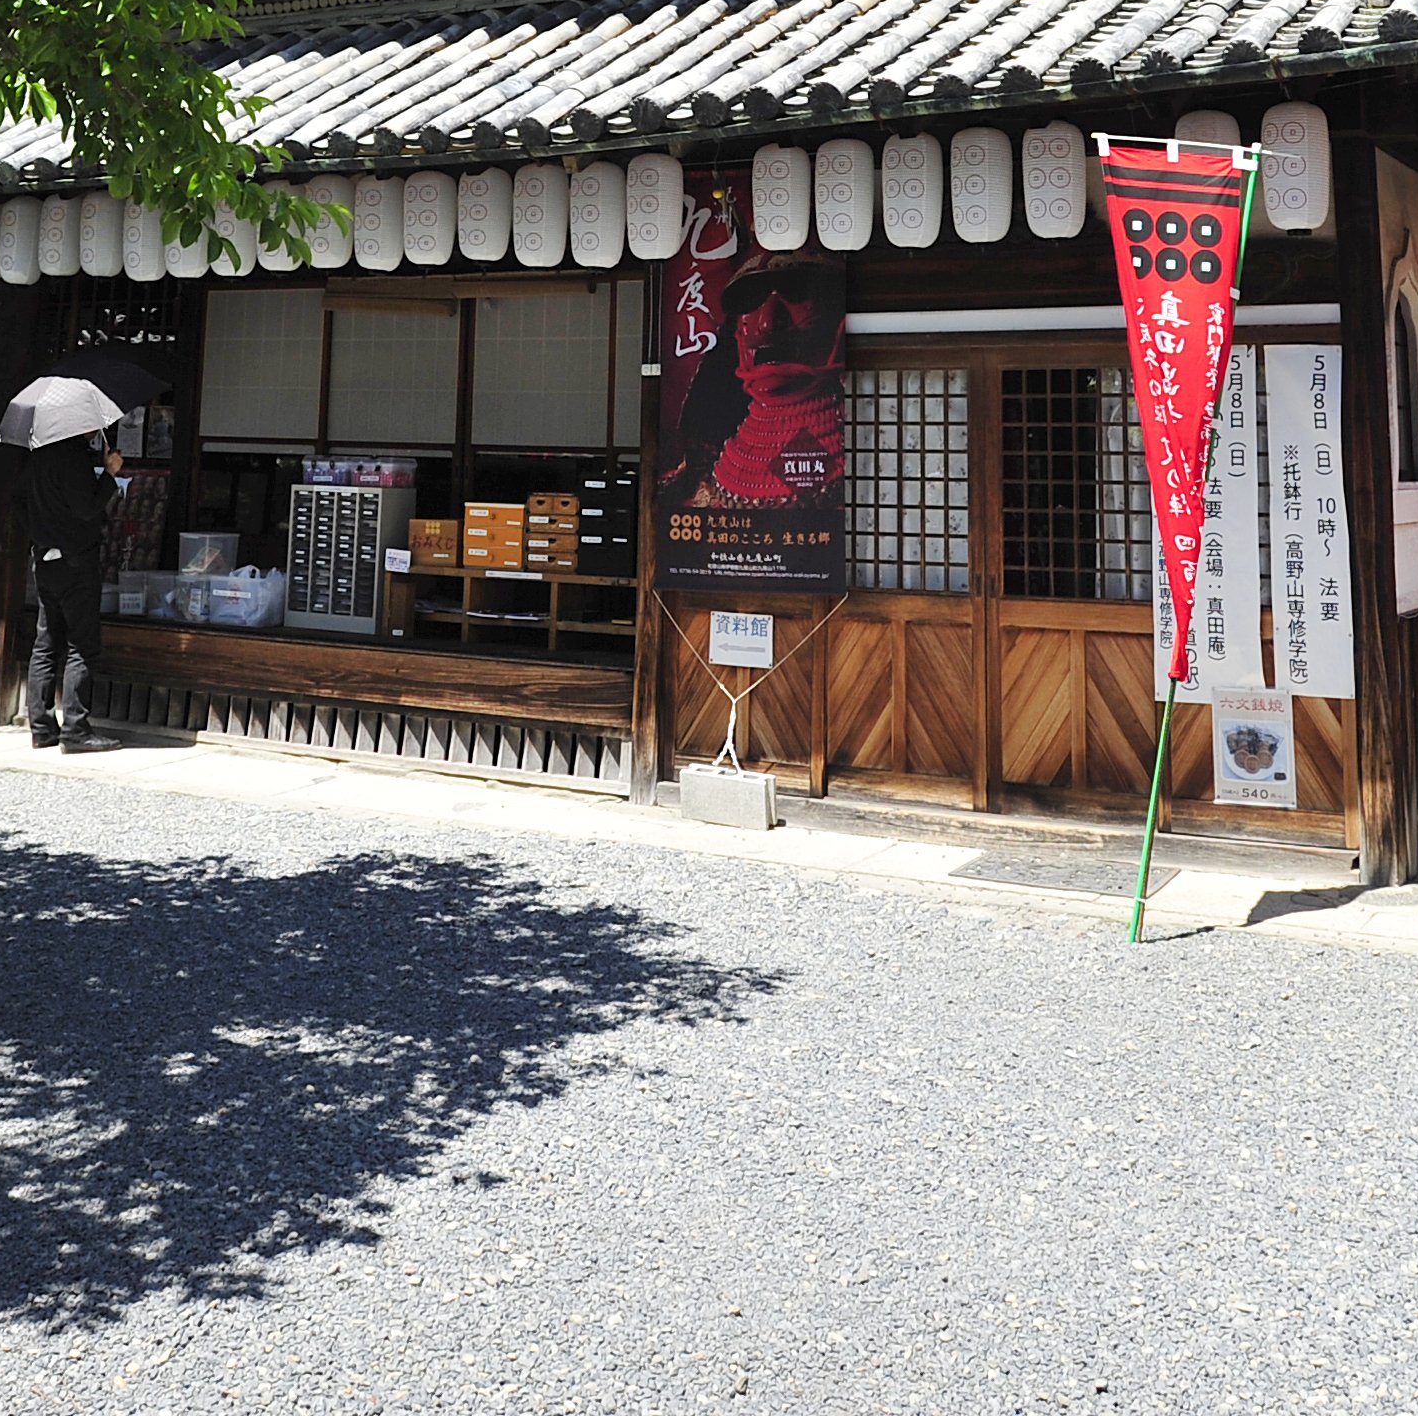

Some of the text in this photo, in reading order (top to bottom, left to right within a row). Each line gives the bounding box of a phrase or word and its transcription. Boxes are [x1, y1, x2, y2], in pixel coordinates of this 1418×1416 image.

[675, 193, 739, 358] 九度山
[706, 515, 753, 529] 九度山は
[412, 537, 455, 550] おみくじ
[706, 532, 832, 546] 真田のこころ 生きる郷
[1320, 576, 1340, 622] 法要
[715, 614, 769, 638] 資料館
